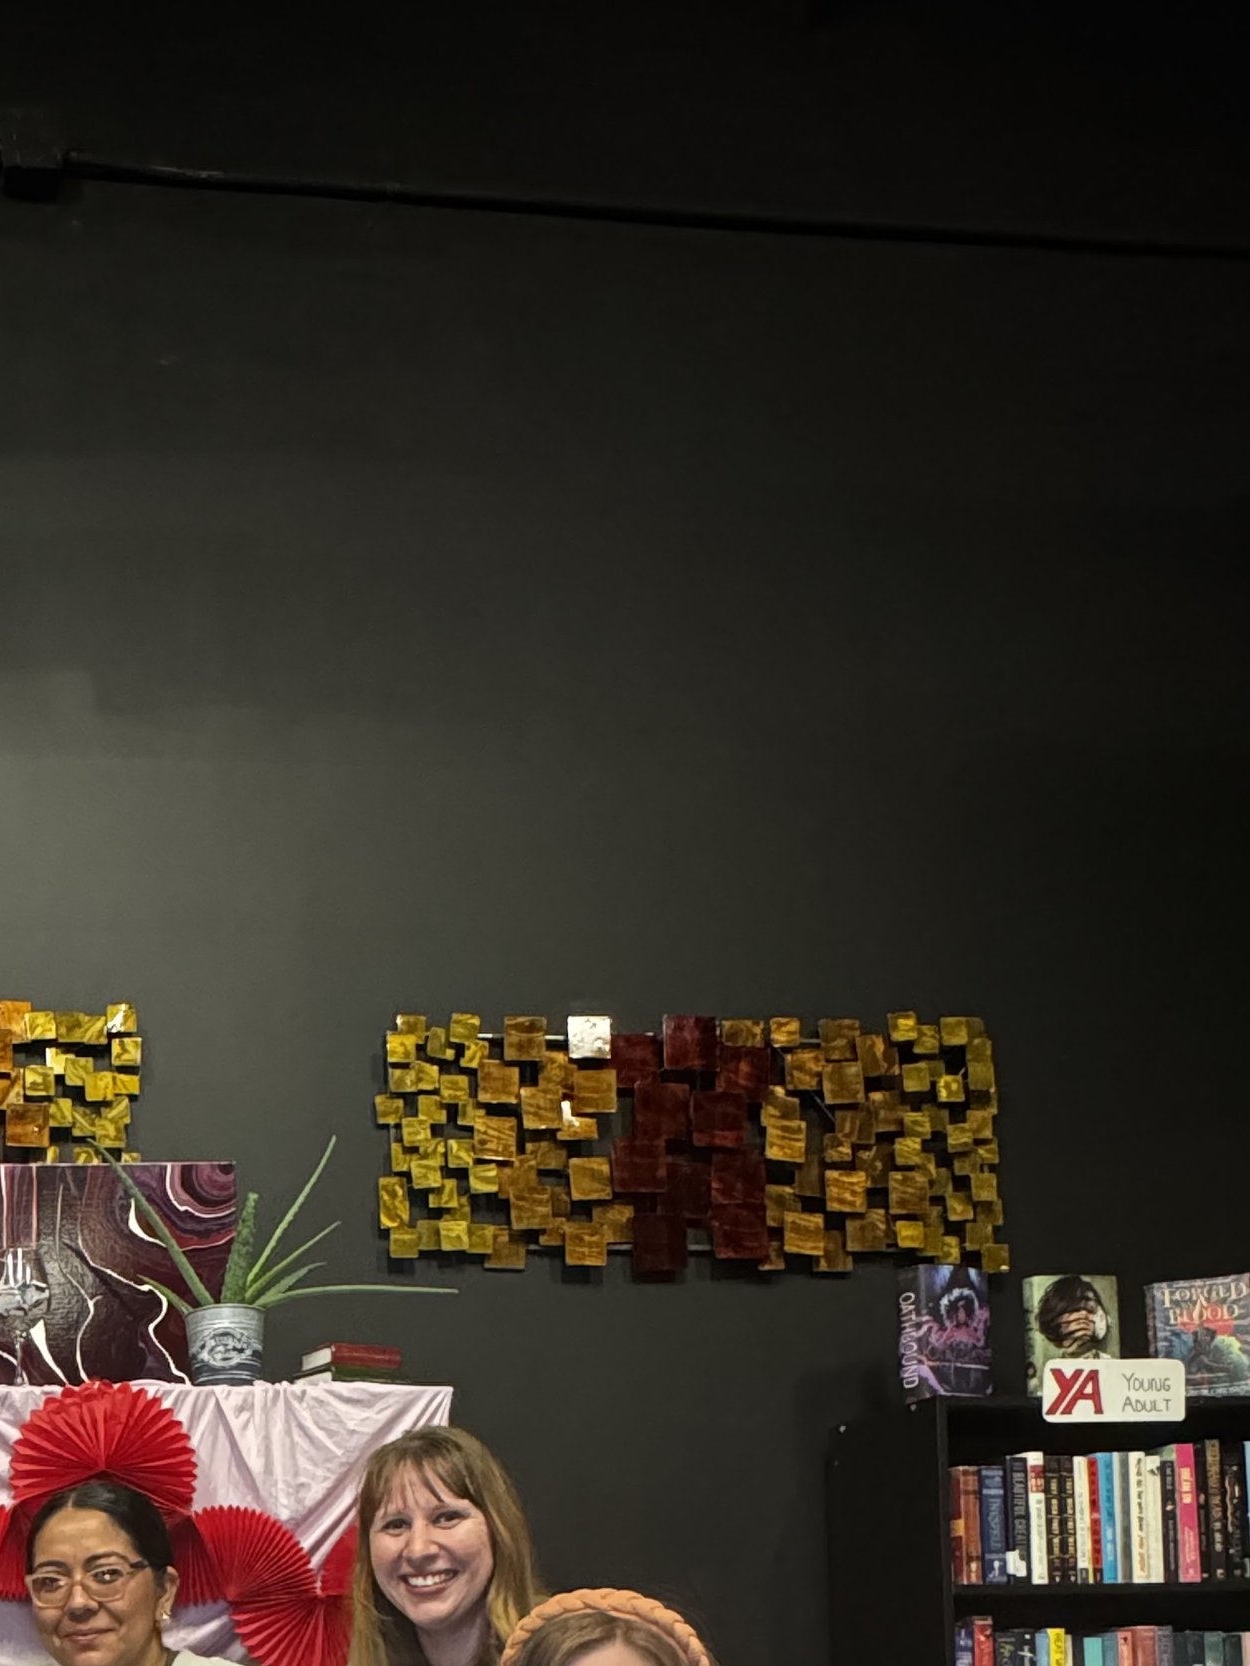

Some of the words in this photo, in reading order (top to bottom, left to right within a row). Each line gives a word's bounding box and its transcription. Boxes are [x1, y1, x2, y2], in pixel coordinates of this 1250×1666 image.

[1045, 1368, 1103, 1415] YA
[1121, 1372, 1171, 1393] YOUNG
[1121, 1397, 1172, 1413] ADULT
